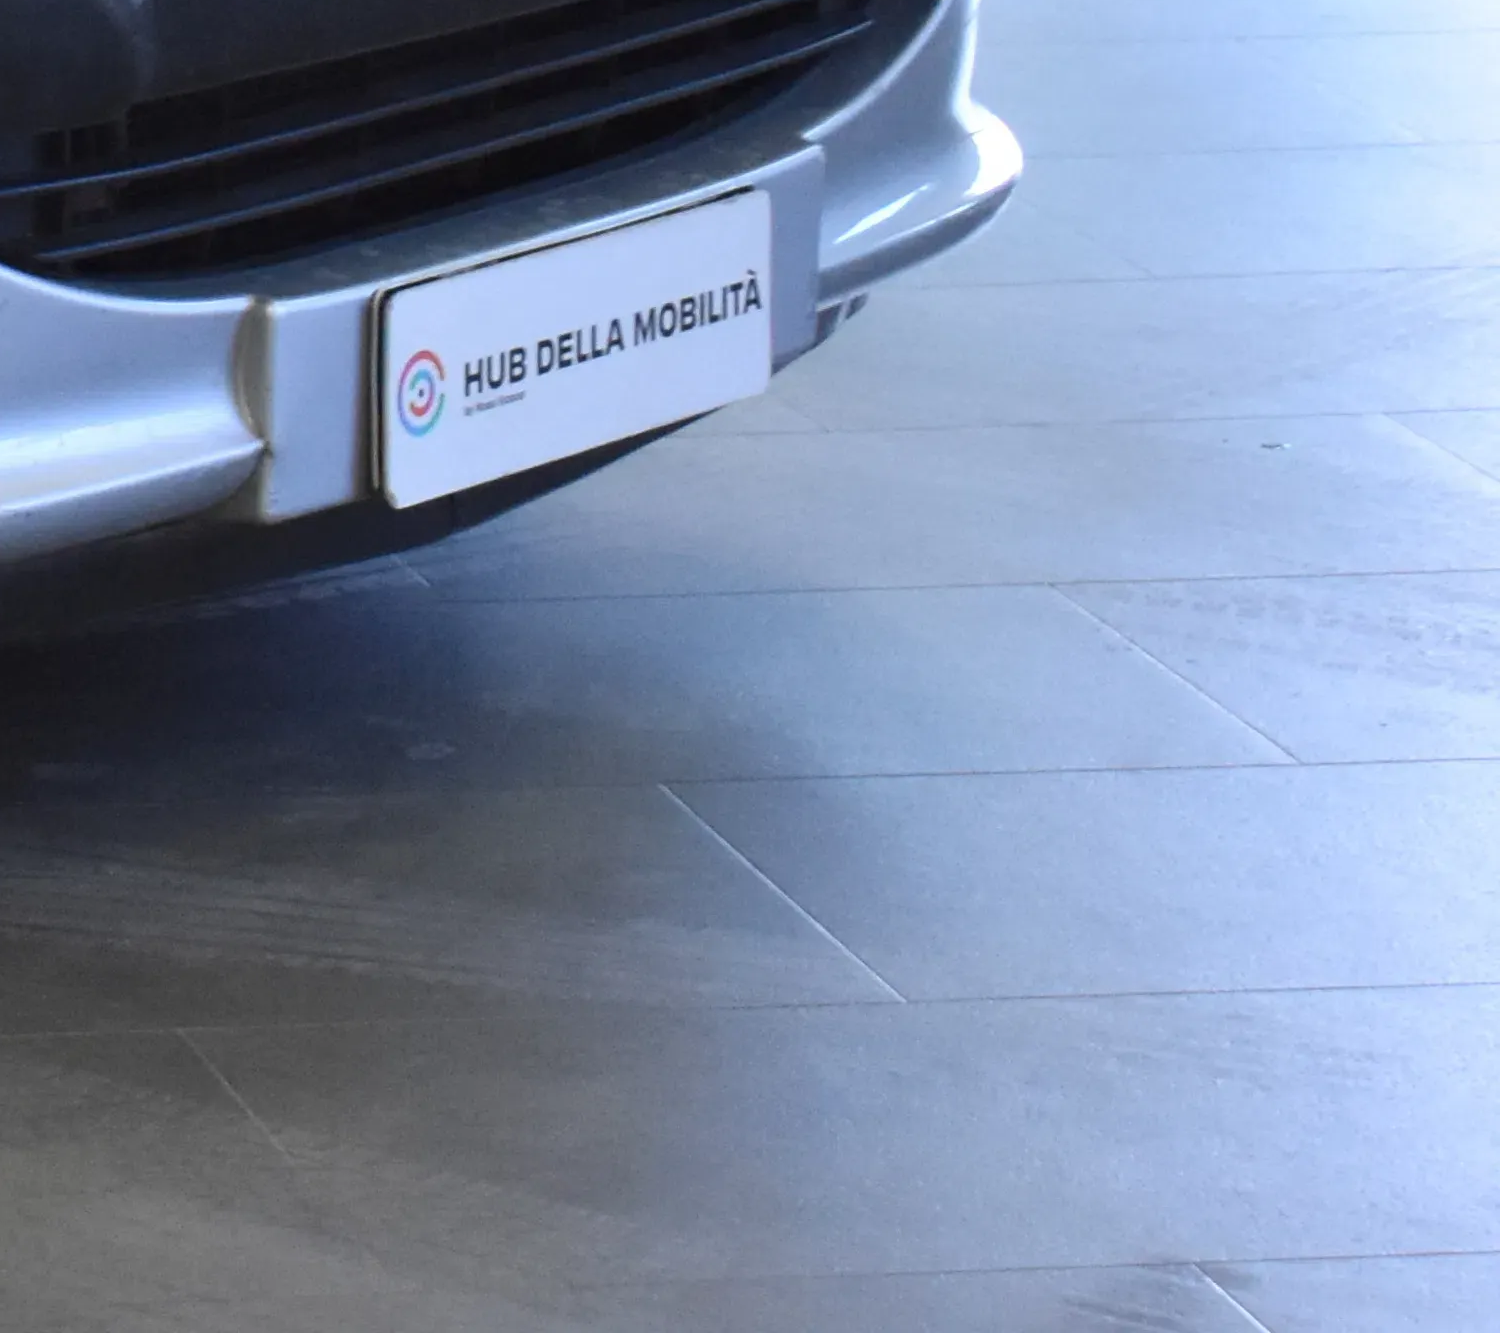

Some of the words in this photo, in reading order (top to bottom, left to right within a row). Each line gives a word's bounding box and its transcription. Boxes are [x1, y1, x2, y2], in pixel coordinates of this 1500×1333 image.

[463, 347, 527, 397] HUB
[537, 318, 625, 375] DELLA
[633, 270, 762, 346] MOBILITÀ
